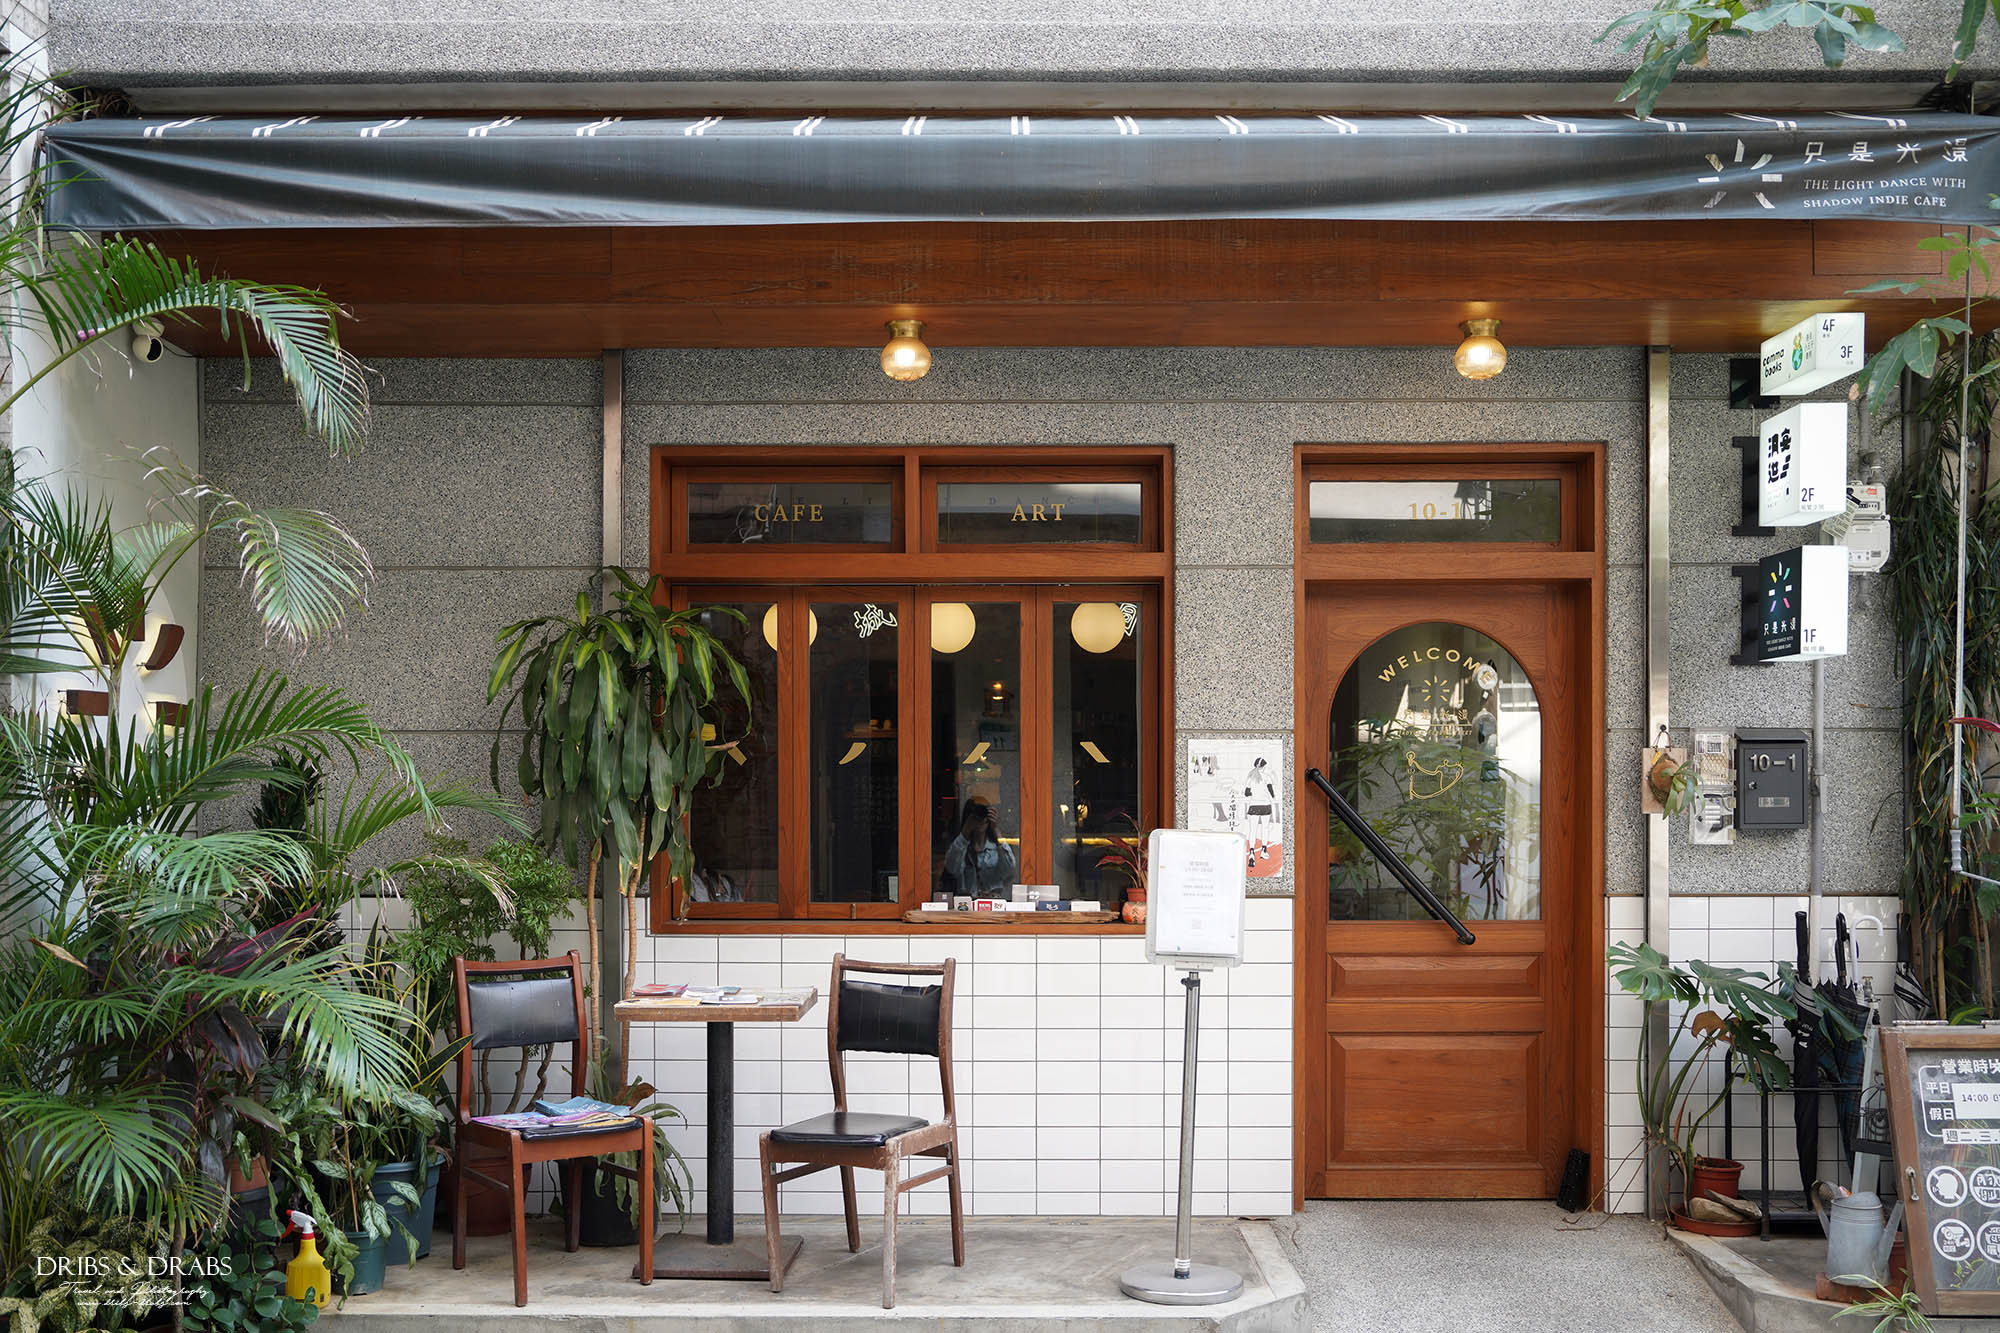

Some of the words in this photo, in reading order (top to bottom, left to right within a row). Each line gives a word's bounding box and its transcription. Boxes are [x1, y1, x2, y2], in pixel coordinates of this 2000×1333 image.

[1803, 179, 1829, 190] THE
[1833, 180, 1874, 190] LIGHT
[1880, 177, 1927, 188] DANCE
[1932, 177, 1966, 189] WITH
[1803, 197, 1863, 208] SHADOW
[1869, 195, 1908, 205] INDIE
[1914, 196, 1947, 207] CAFE
[1823, 319, 1835, 332] 4F
[1840, 345, 1853, 359] 3F
[1764, 361, 1782, 378] books
[1801, 487, 1815, 502] 2F
[754, 504, 824, 522] CAFE
[1011, 503, 1066, 521] ART
[1408, 502, 1462, 520] 10-1
[1803, 628, 1817, 643] 1F
[1378, 647, 1493, 684] WELCOME
[1749, 753, 1797, 772] 10-1
[1926, 1081, 1950, 1095] 平日
[1961, 1094, 1989, 1103] 14:00
[1929, 1107, 1954, 1121] 假日
